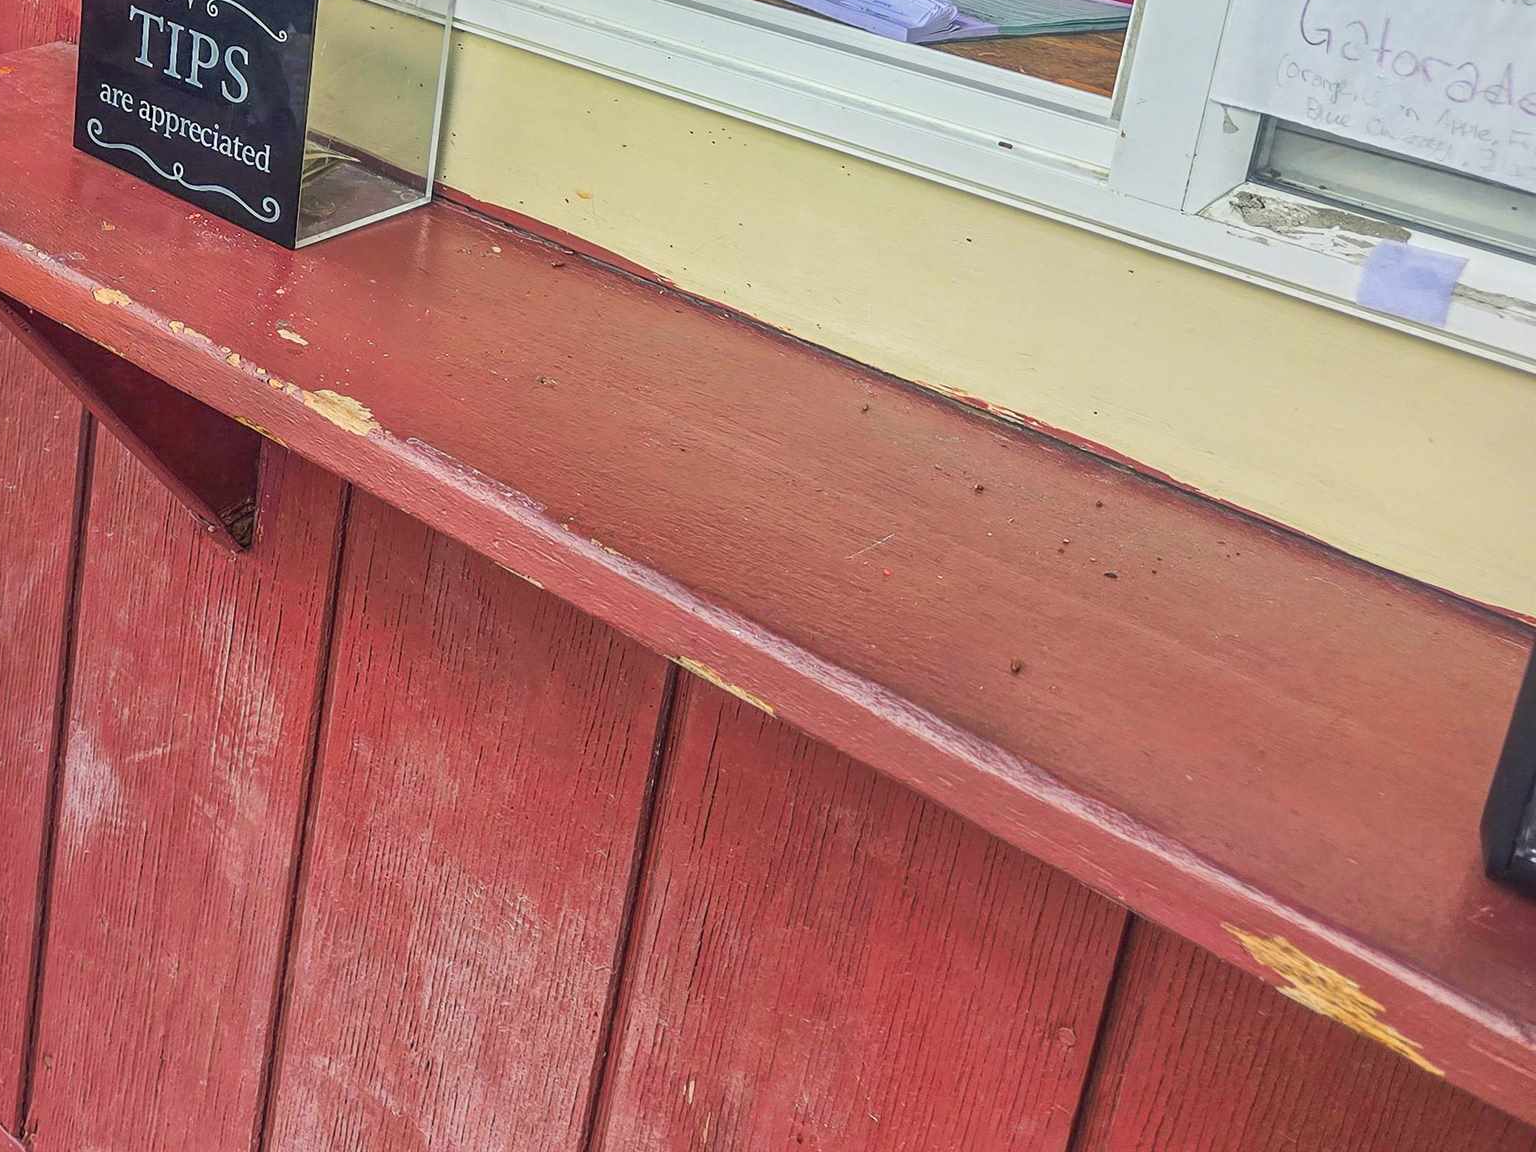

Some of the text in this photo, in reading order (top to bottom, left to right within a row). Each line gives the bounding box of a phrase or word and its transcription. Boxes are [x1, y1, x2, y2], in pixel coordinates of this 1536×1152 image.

[129, 4, 250, 105] TIPS
[99, 81, 272, 174] are appreciated
